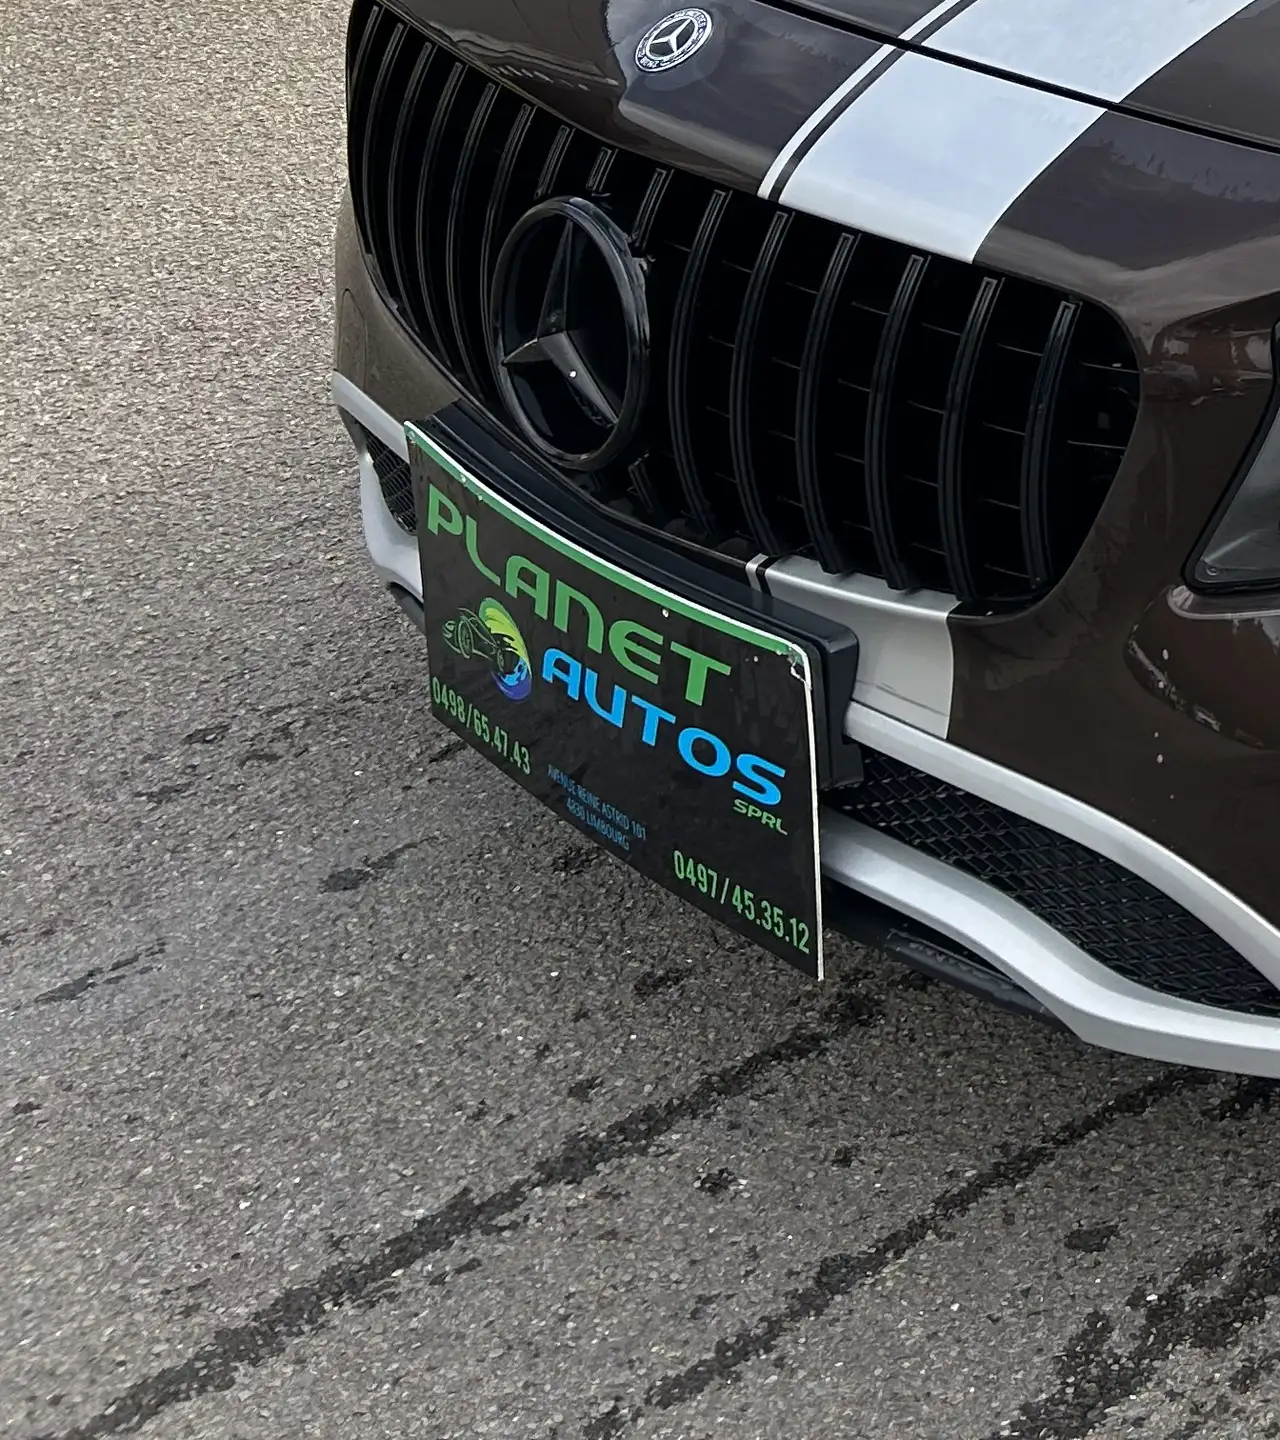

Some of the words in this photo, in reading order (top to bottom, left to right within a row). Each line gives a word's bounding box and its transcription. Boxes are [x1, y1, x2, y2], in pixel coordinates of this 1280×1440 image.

[426, 483, 733, 708] PLANET
[431, 676, 532, 776] 0498/65.47.43
[541, 647, 788, 807] AUTOS
[586, 809, 630, 851] LIMBOURG
[601, 802, 630, 831] ASTRID
[631, 820, 647, 841] 101
[732, 798, 789, 836] SPRL
[673, 849, 810, 955] 0497/45.35.12
